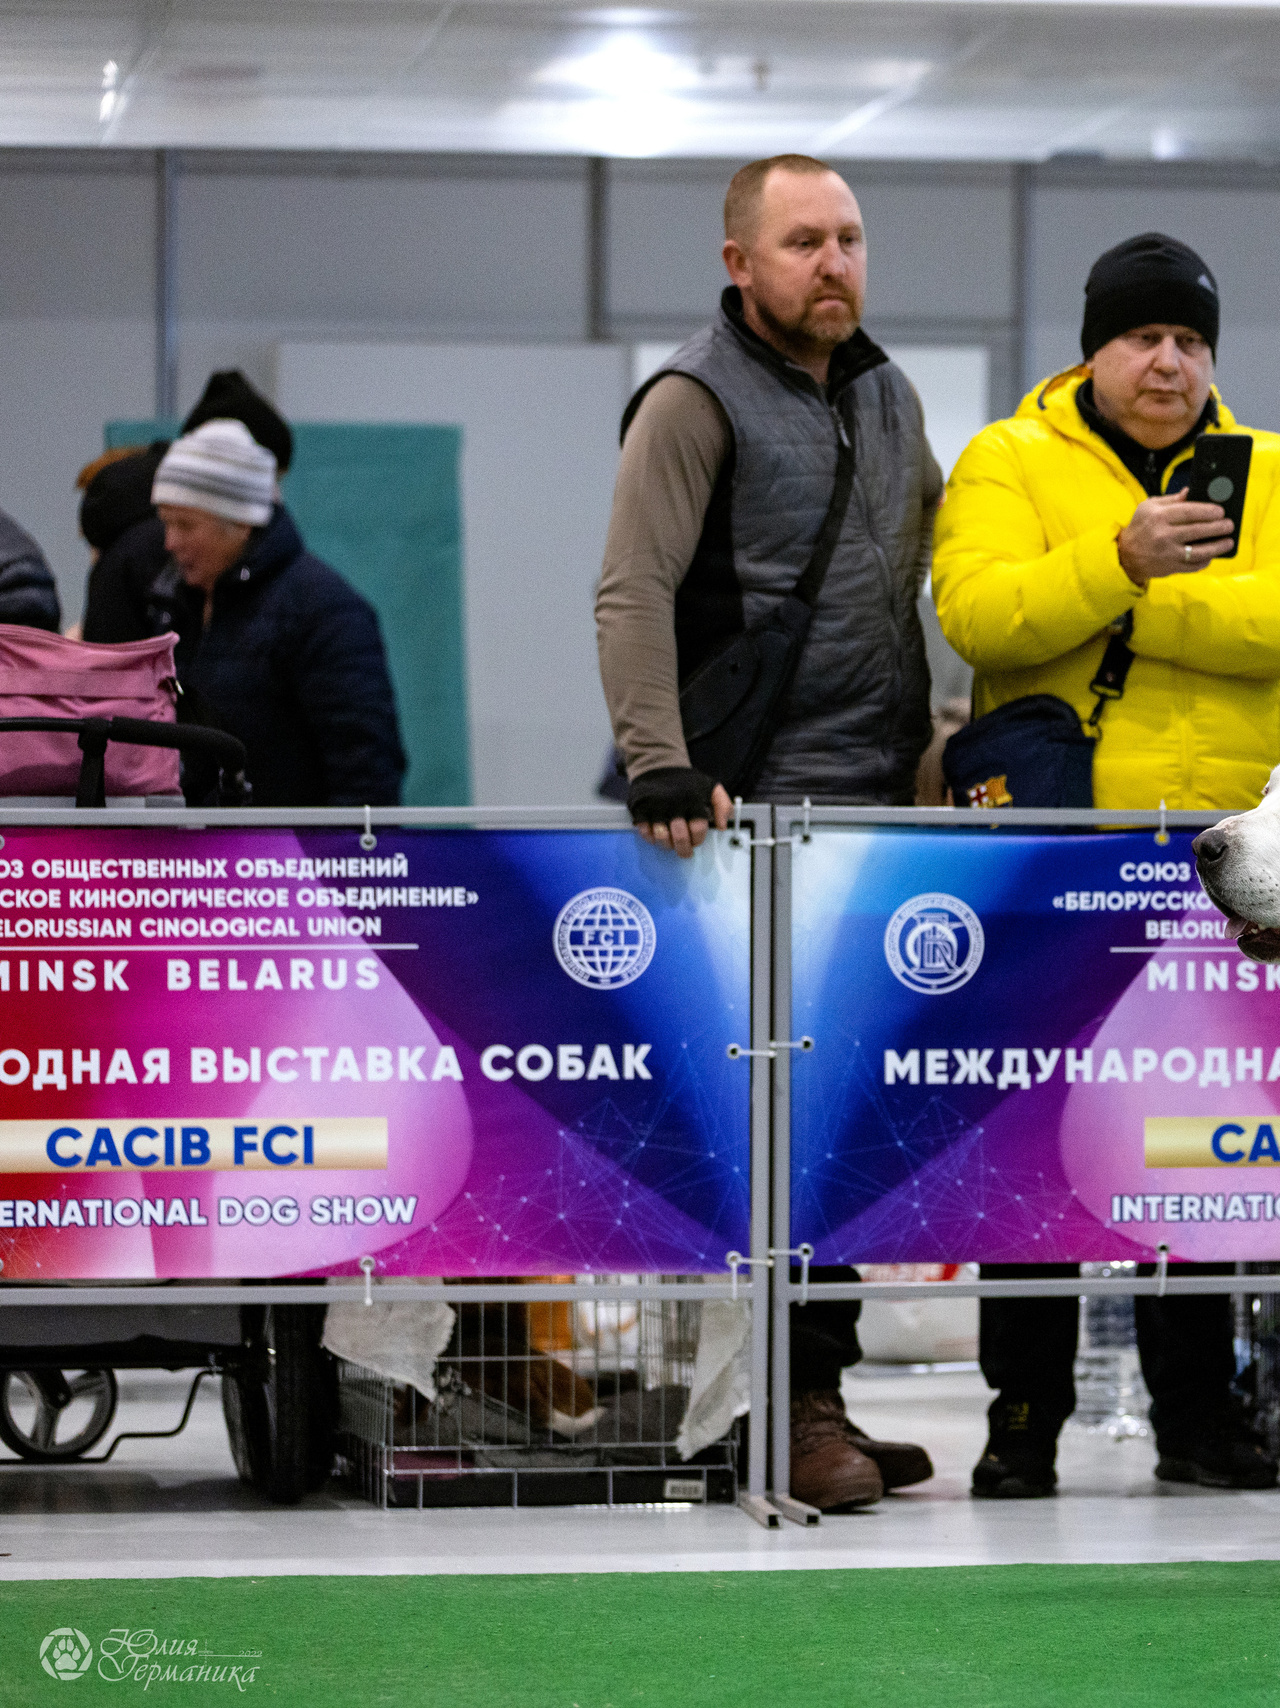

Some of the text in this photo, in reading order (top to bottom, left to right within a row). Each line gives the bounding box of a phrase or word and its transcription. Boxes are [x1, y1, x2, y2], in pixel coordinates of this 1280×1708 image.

[31, 858, 228, 882] ОБЩЕСТВЕННЫХ
[235, 852, 408, 881] ОБЪЕДИНЕНИЙ
[1119, 861, 1191, 882] СОЮЗ
[69, 887, 289, 908] КИНОЛОГИЧЕСКОЕ
[296, 886, 479, 910] ОБЪЕДИНЕНИЕ»
[1052, 890, 1219, 912] «БЕЛОРУССКО
[0, 916, 382, 938] LORUSSIAN CINOLOGICAL UNION
[583, 930, 625, 947] FCI
[167, 958, 380, 991] BELARUS
[191, 1045, 464, 1084] ВЫСТАВКА
[480, 1043, 653, 1081] СОБАК
[46, 1125, 315, 1168] CACIB FCI
[218, 1195, 300, 1227] DOG
[310, 1194, 418, 1226] SHOW
